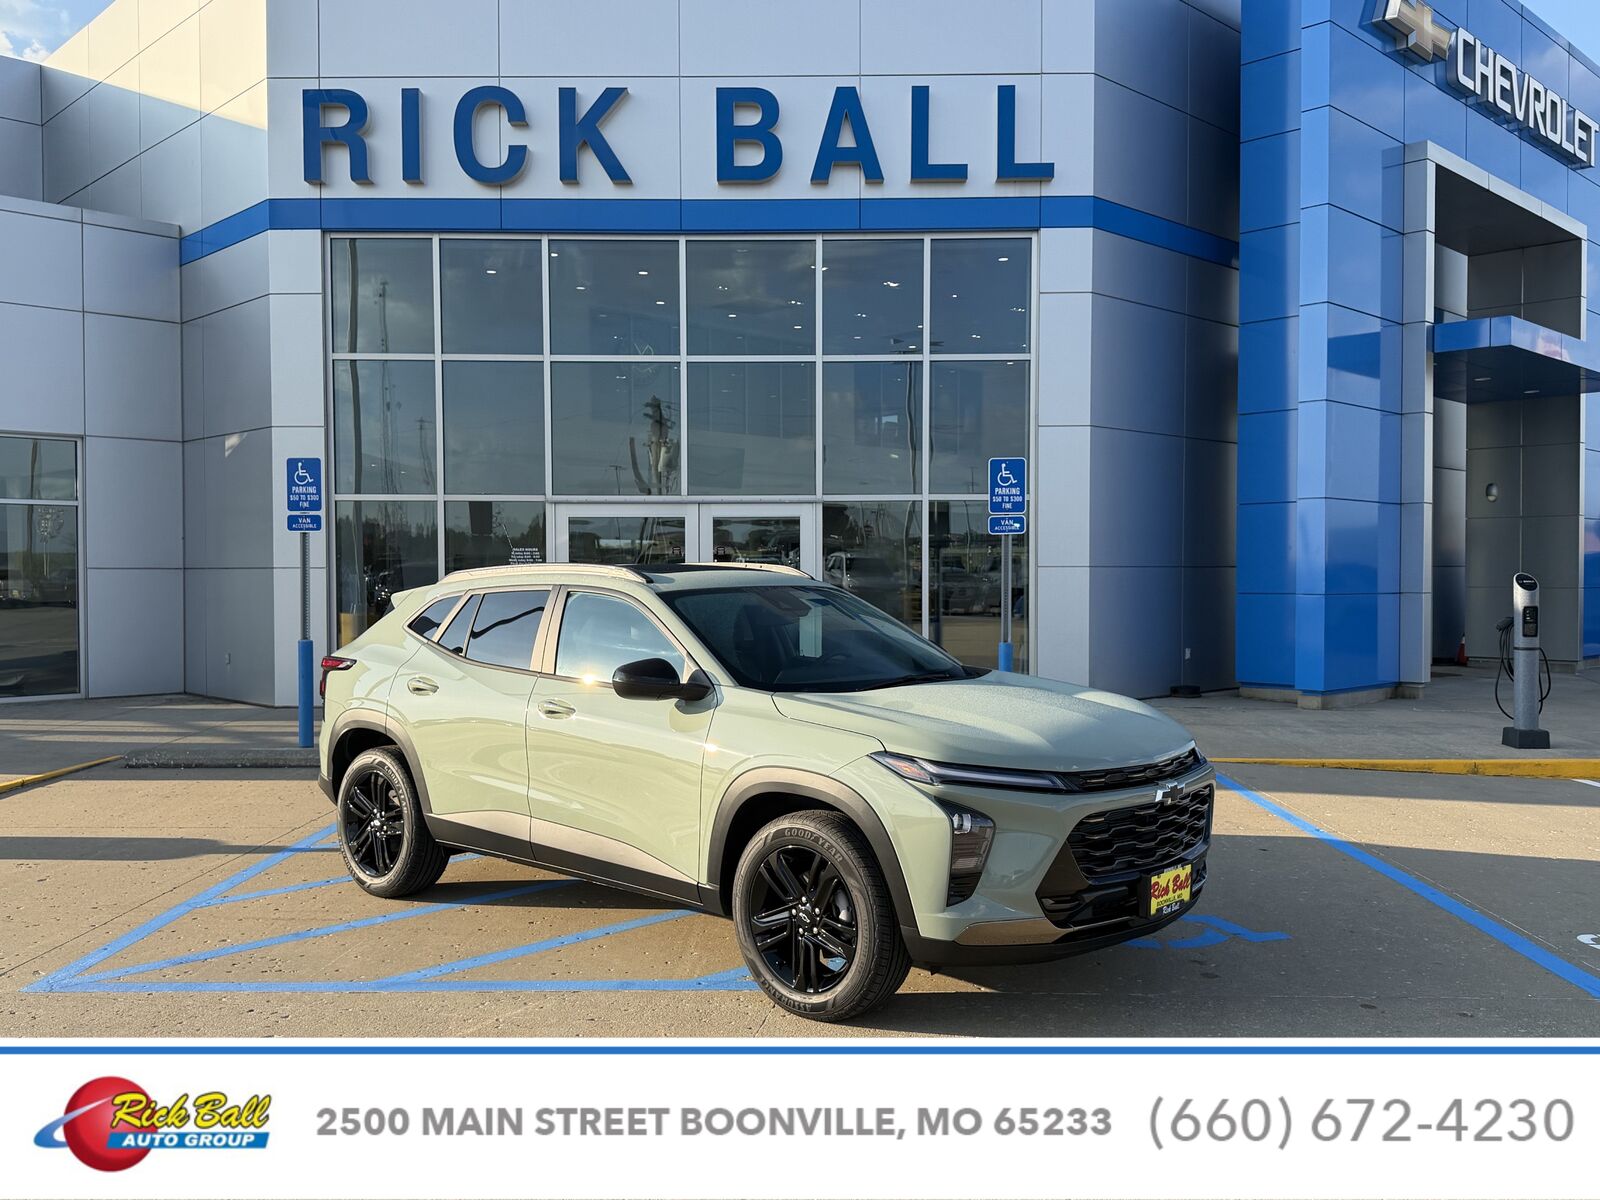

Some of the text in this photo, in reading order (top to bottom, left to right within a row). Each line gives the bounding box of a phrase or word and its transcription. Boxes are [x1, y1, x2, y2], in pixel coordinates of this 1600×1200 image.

[302, 85, 1055, 186] RICK BALL
[1454, 27, 1600, 168] CHEVROLET
[1151, 872, 1191, 900] Rick Ball
